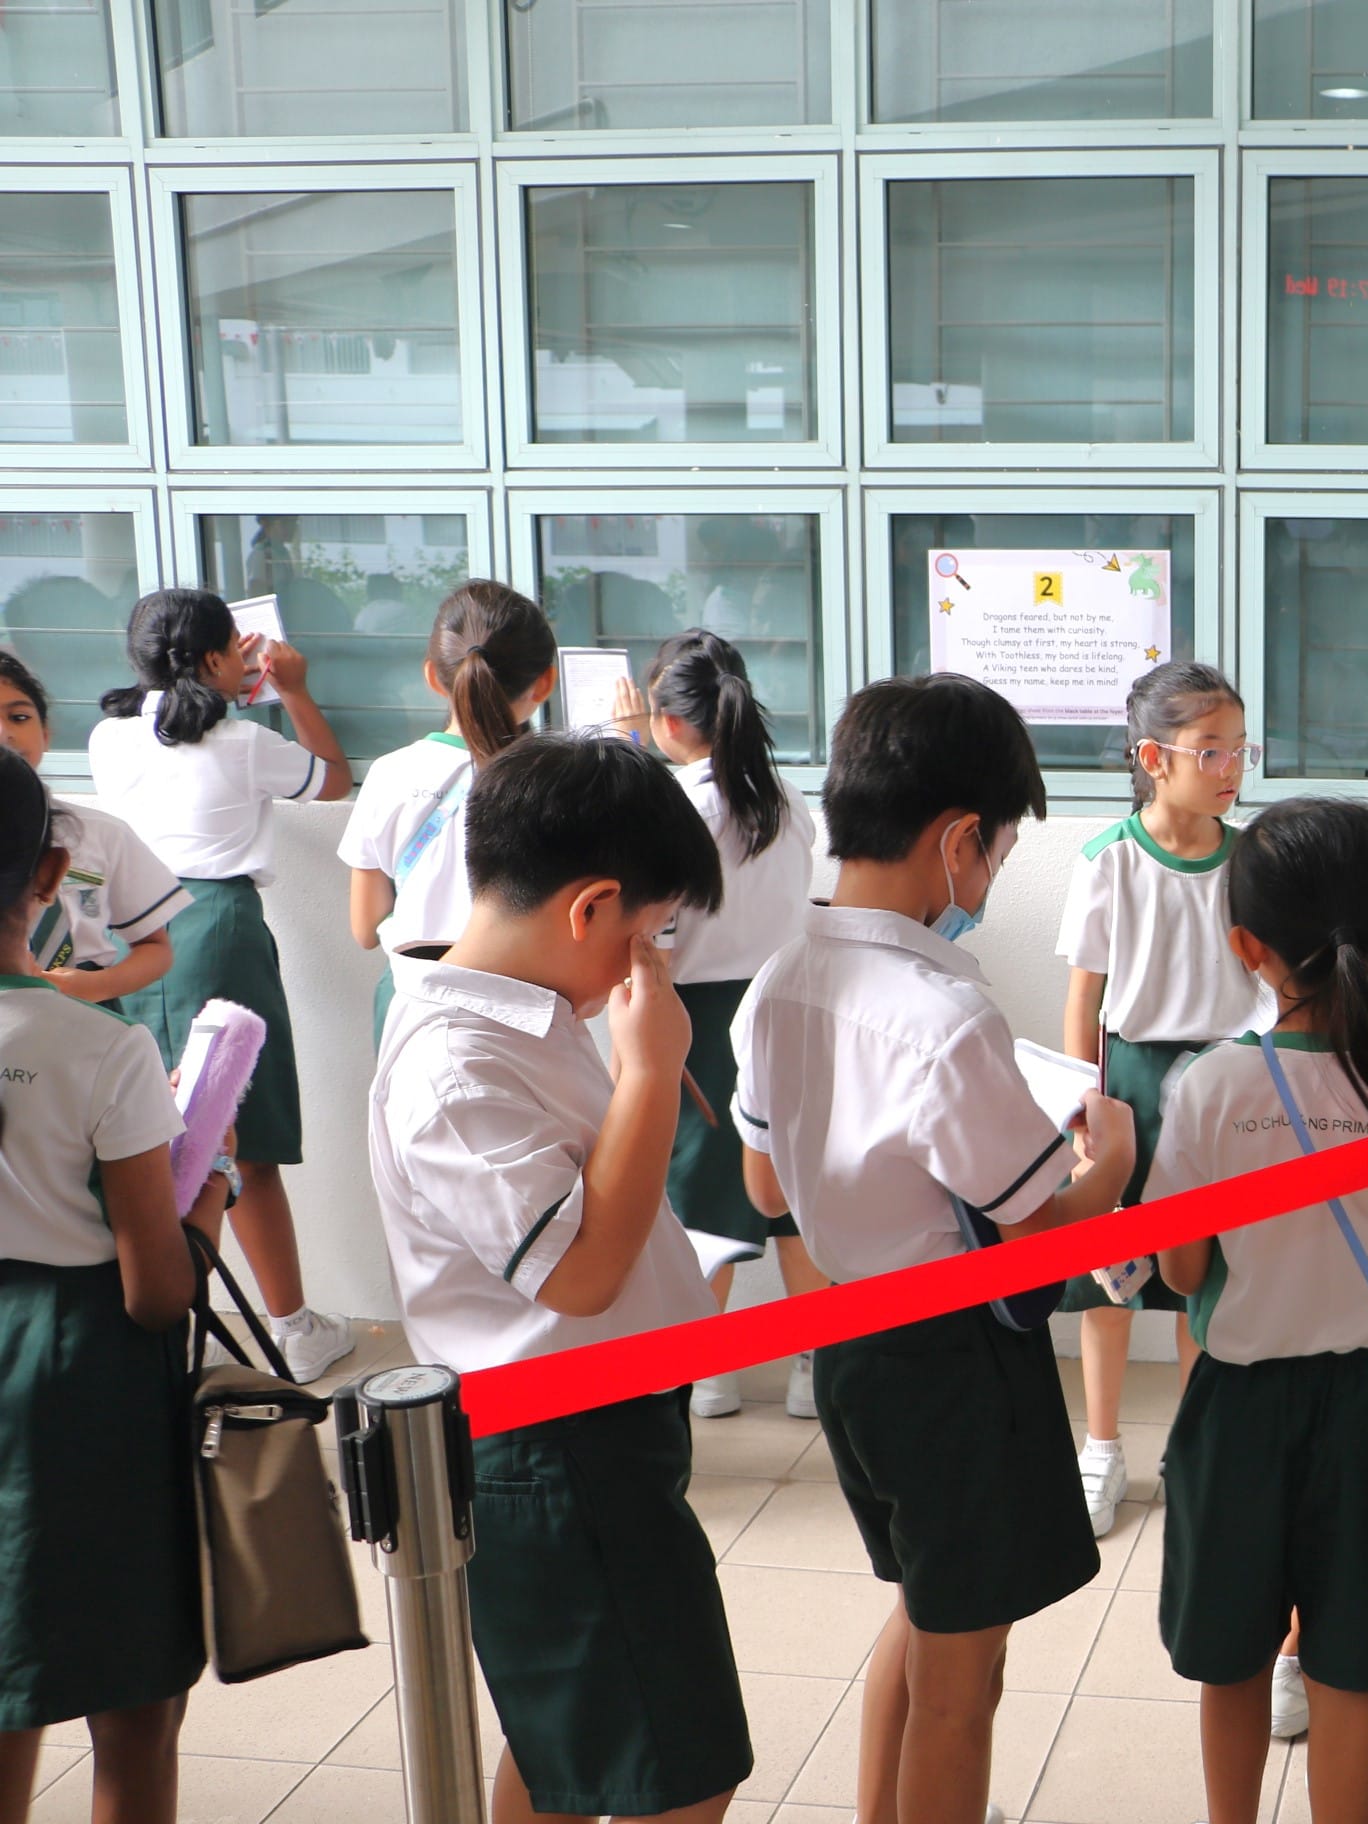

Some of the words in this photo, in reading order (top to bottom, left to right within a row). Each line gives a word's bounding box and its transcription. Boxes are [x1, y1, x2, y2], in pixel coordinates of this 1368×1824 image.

[1039, 576, 1054, 596] 2
[983, 613, 1017, 623] Dragons
[1019, 613, 1050, 622] feared,
[1053, 613, 1067, 622] but
[1070, 613, 1083, 622] not
[1086, 613, 1096, 624] by
[1099, 615, 1114, 624] me,
[993, 626, 997, 634] I
[1000, 626, 1021, 634] tame
[1023, 626, 1045, 634] them
[1047, 626, 1066, 634] with
[961, 638, 991, 648] Though
[993, 638, 1020, 648] clumsy
[1023, 638, 1032, 647] at
[1035, 638, 1058, 648] first,
[1060, 641, 1072, 649] my
[1074, 638, 1097, 647] heart
[1100, 638, 1107, 647] is
[976, 651, 997, 660] With
[1000, 651, 1043, 661] Toothless,
[1045, 653, 1057, 662] my
[1059, 651, 1080, 660] bond
[1082, 651, 1089, 660] is
[983, 664, 989, 673] A
[992, 664, 1017, 674] Viking
[1019, 664, 1038, 673] teen
[1041, 664, 1057, 673] who
[1059, 664, 1082, 673] dares
[1085, 664, 1096, 673] be
[1098, 664, 1118, 674] kind,
[983, 677, 1007, 685] Guess
[1009, 678, 1021, 687] my
[1024, 677, 1048, 686] name,
[1050, 677, 1070, 687] keep
[1072, 677, 1084, 685] me
[1087, 677, 1094, 685] in
[1096, 677, 1118, 685] mind!
[1233, 1119, 1258, 1134] YIO
